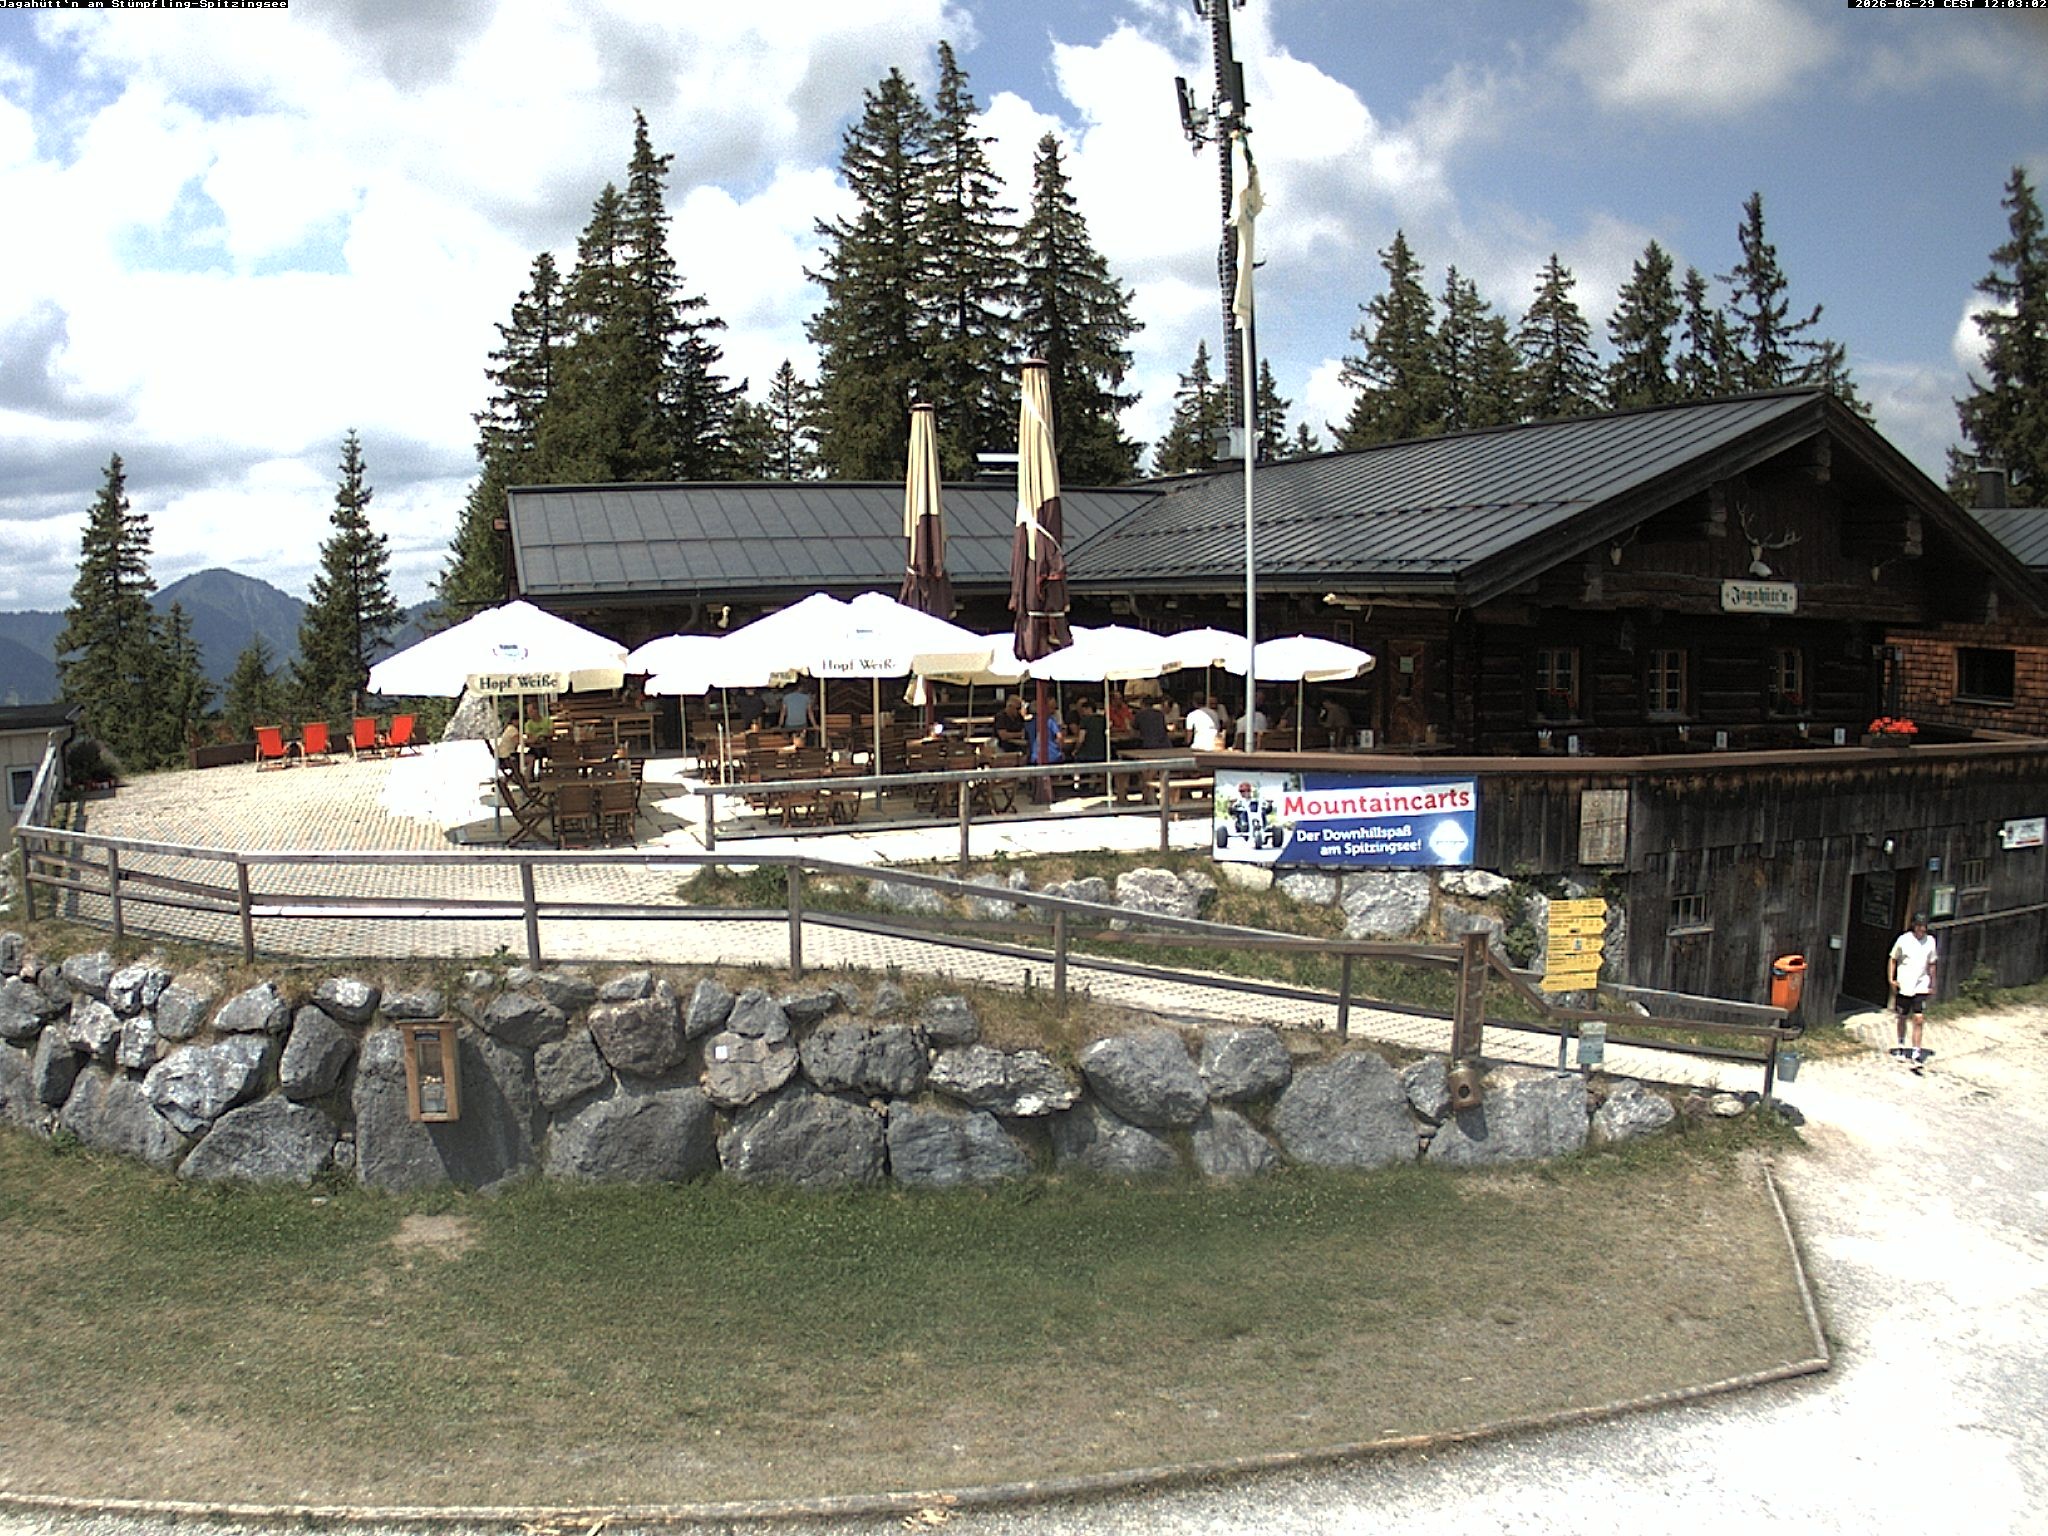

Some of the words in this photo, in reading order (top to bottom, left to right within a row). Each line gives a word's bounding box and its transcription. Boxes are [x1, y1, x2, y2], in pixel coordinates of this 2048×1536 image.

[480, 677, 512, 692] Hopf
[518, 674, 559, 688] Weiße
[1283, 789, 1470, 817] Mountaincarts
[1296, 828, 1321, 843] Der
[1322, 824, 1412, 843] Downhillspaß
[1320, 845, 1342, 856] am
[1344, 838, 1422, 856] Spitzingsee!
